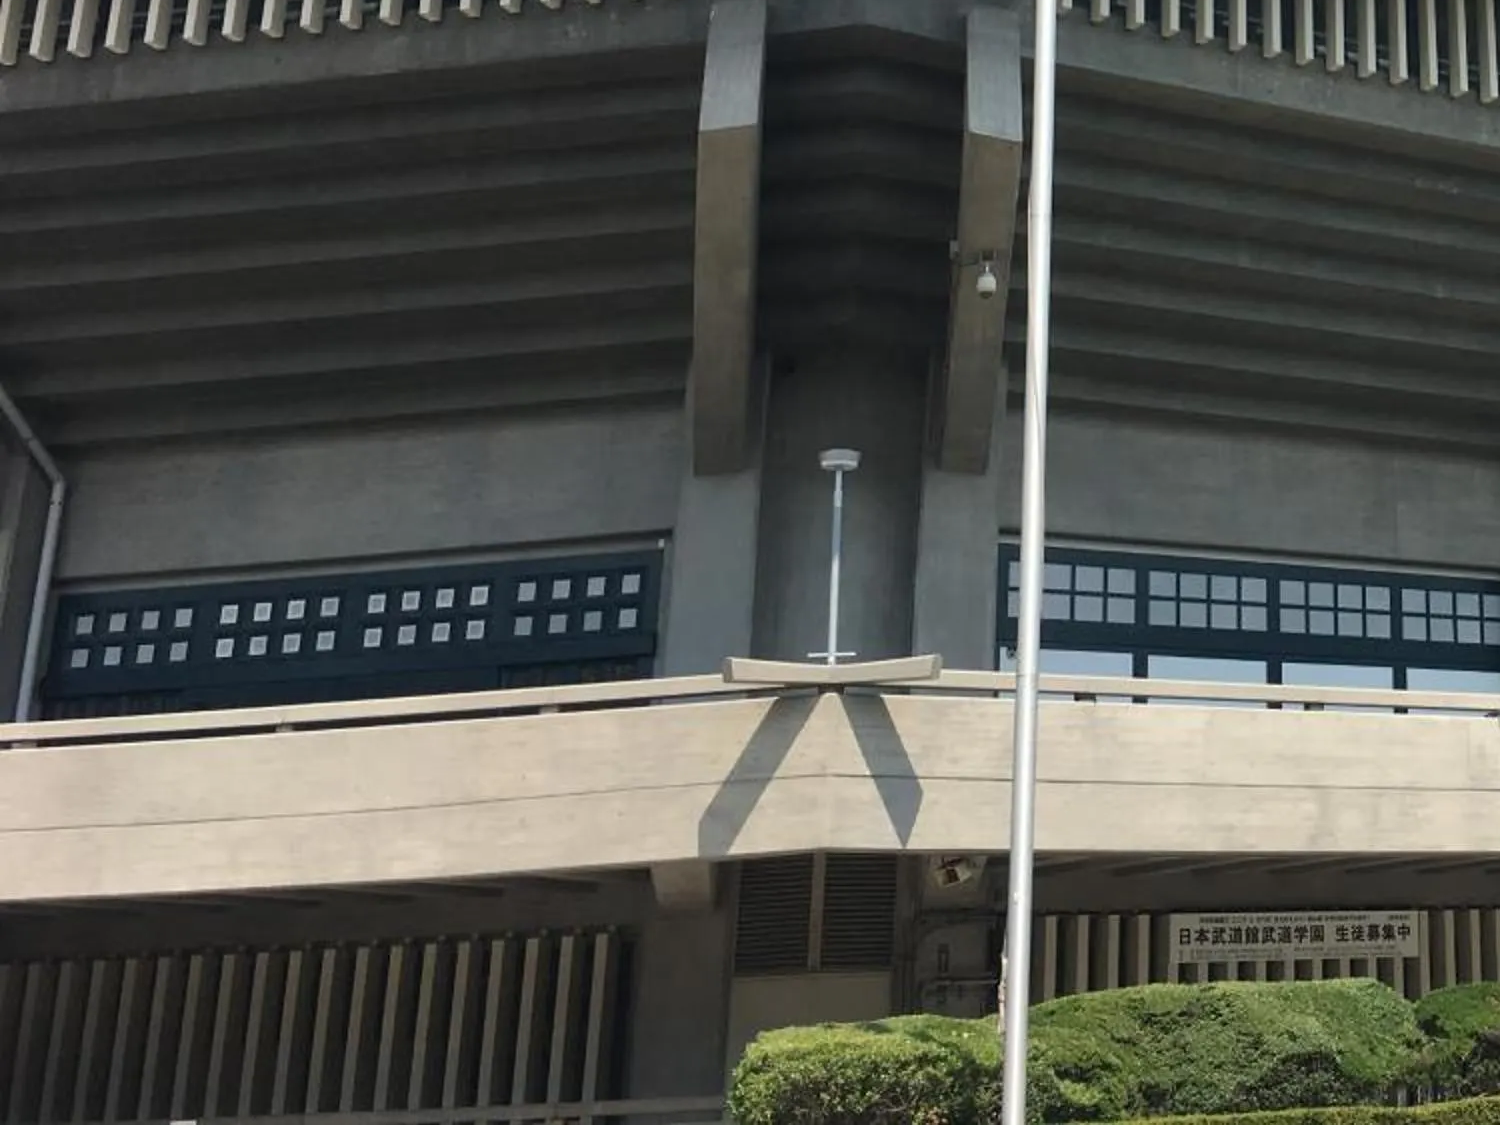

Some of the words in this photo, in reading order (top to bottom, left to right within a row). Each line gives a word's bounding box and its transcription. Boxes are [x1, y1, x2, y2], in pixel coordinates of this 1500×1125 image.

[1178, 925, 1325, 945] 日本武道館武道学園
[1335, 924, 1412, 942] 生徒募集中
